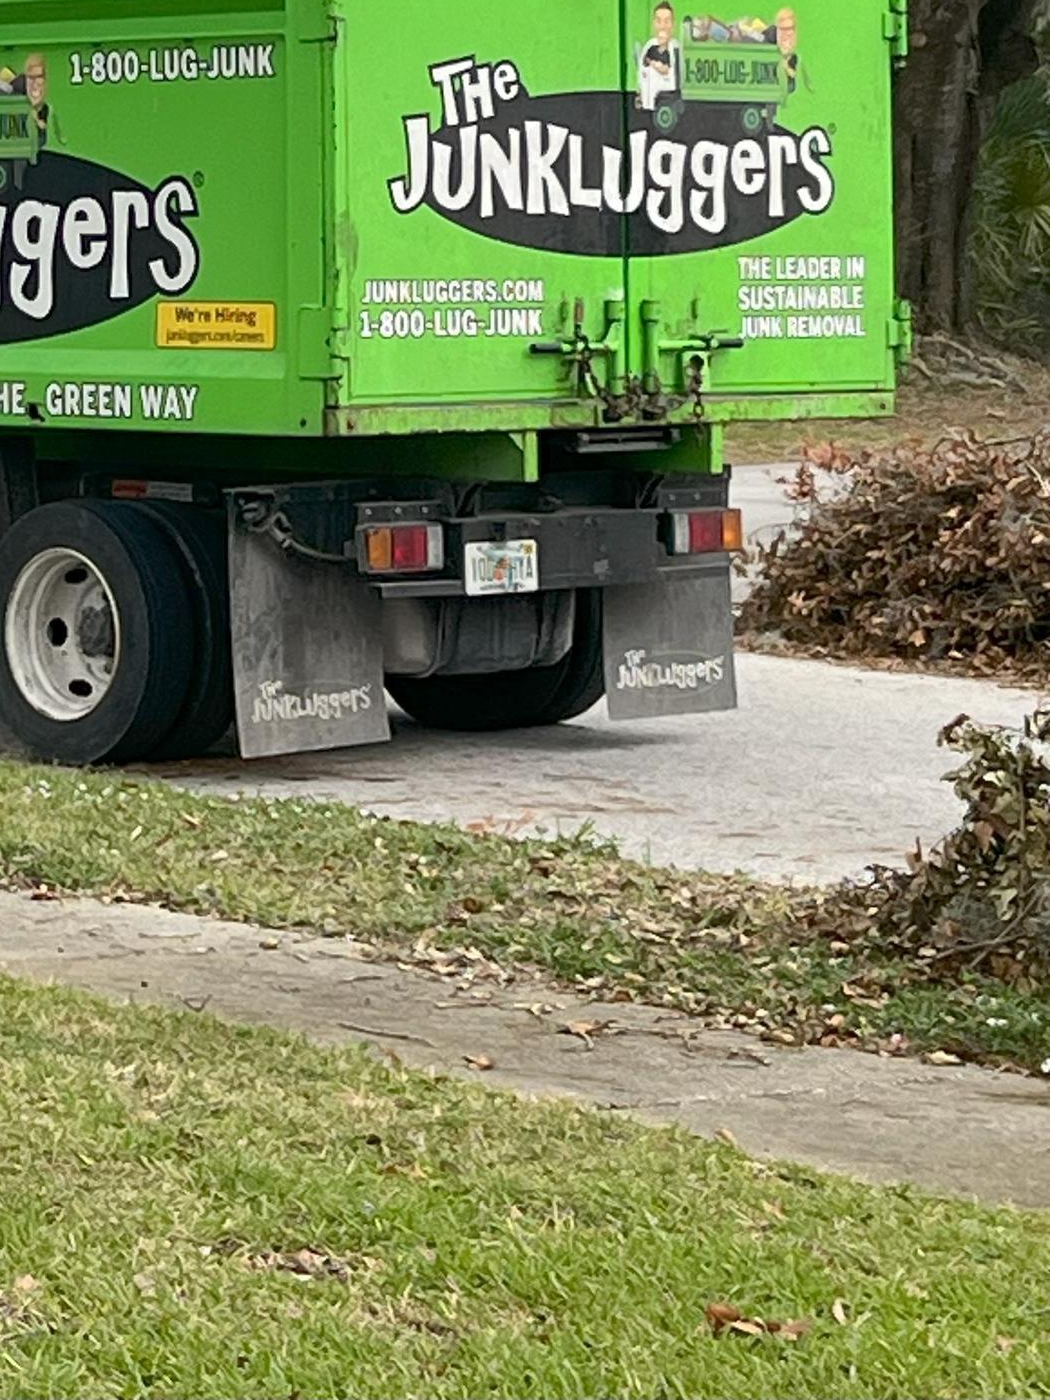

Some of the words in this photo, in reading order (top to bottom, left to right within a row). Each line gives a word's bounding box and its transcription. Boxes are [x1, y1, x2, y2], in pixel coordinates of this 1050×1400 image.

[70, 44, 275, 84] 1-800-LUG-JUNK
[737, 256, 771, 280] THE
[775, 256, 841, 280] LEADER
[846, 256, 865, 279] IN
[361, 280, 544, 303] JUNKLUGGERS.COM
[738, 285, 864, 310] SUSTAINABLE
[175, 307, 211, 323] We're
[215, 307, 257, 327] Hiring
[360, 309, 543, 338] 1-800-LUG-JUNK
[738, 315, 783, 339] JUNK
[787, 315, 866, 338] REMOVAL
[46, 383, 131, 417] GREEN
[140, 384, 198, 419] WAY
